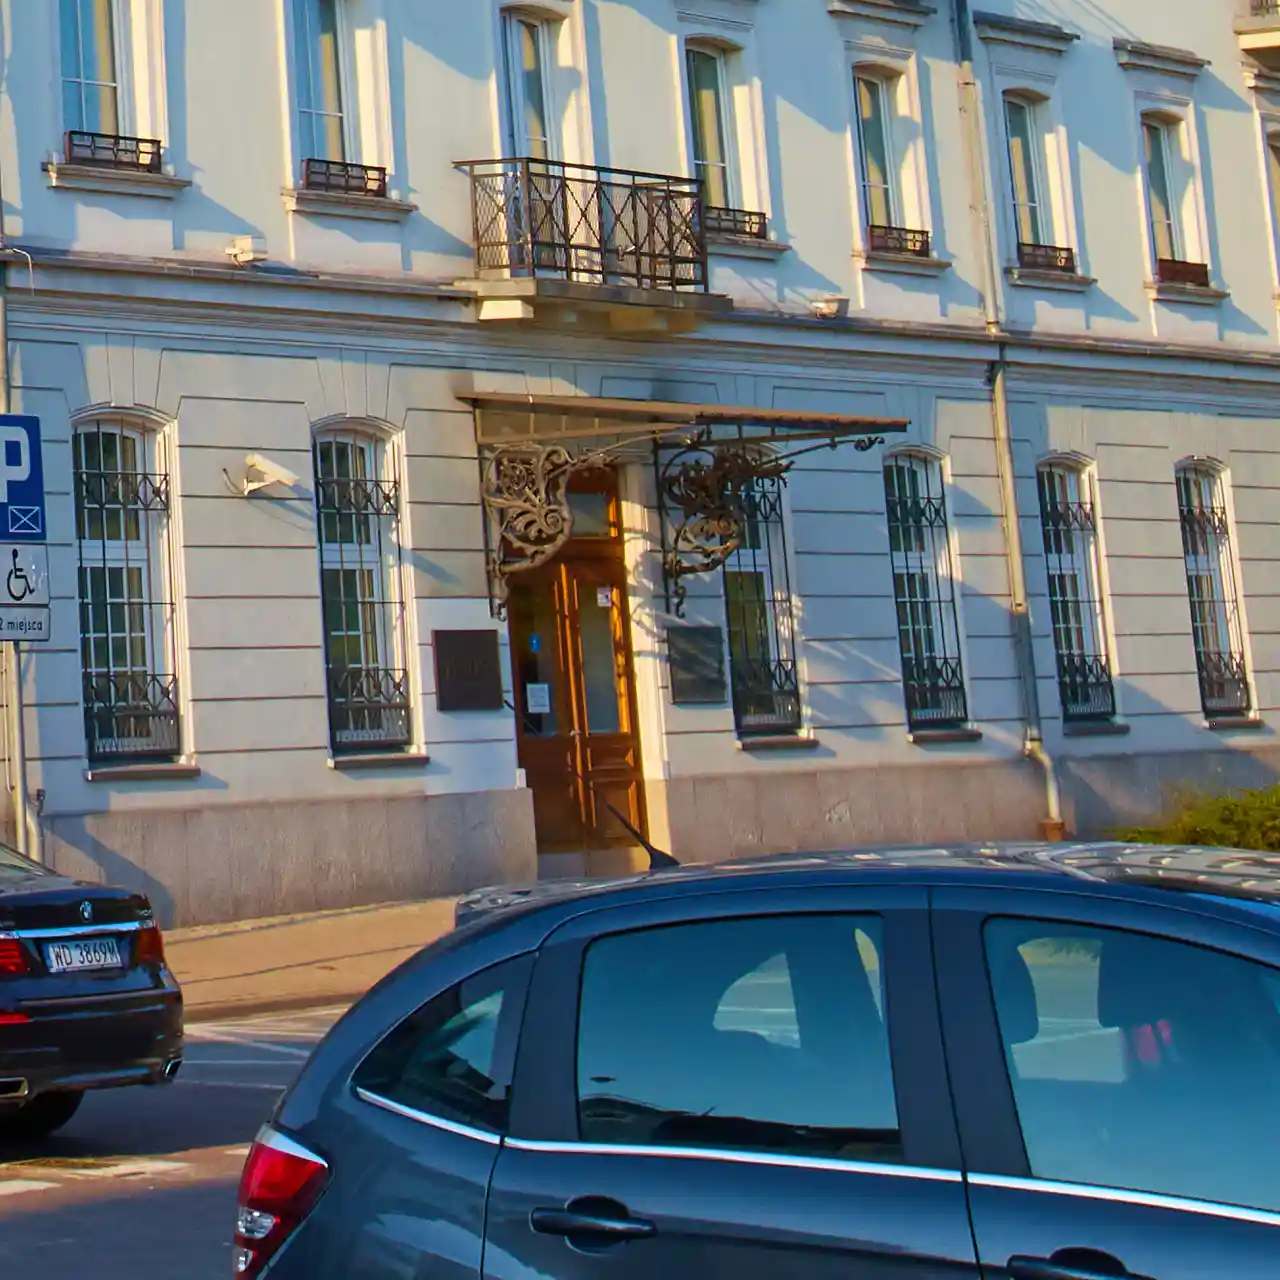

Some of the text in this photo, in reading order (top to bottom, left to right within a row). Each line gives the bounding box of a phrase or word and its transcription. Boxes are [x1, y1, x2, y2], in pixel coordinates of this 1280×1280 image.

[7, 616, 43, 634] miejsca
[53, 942, 119, 967] WD 3869M
